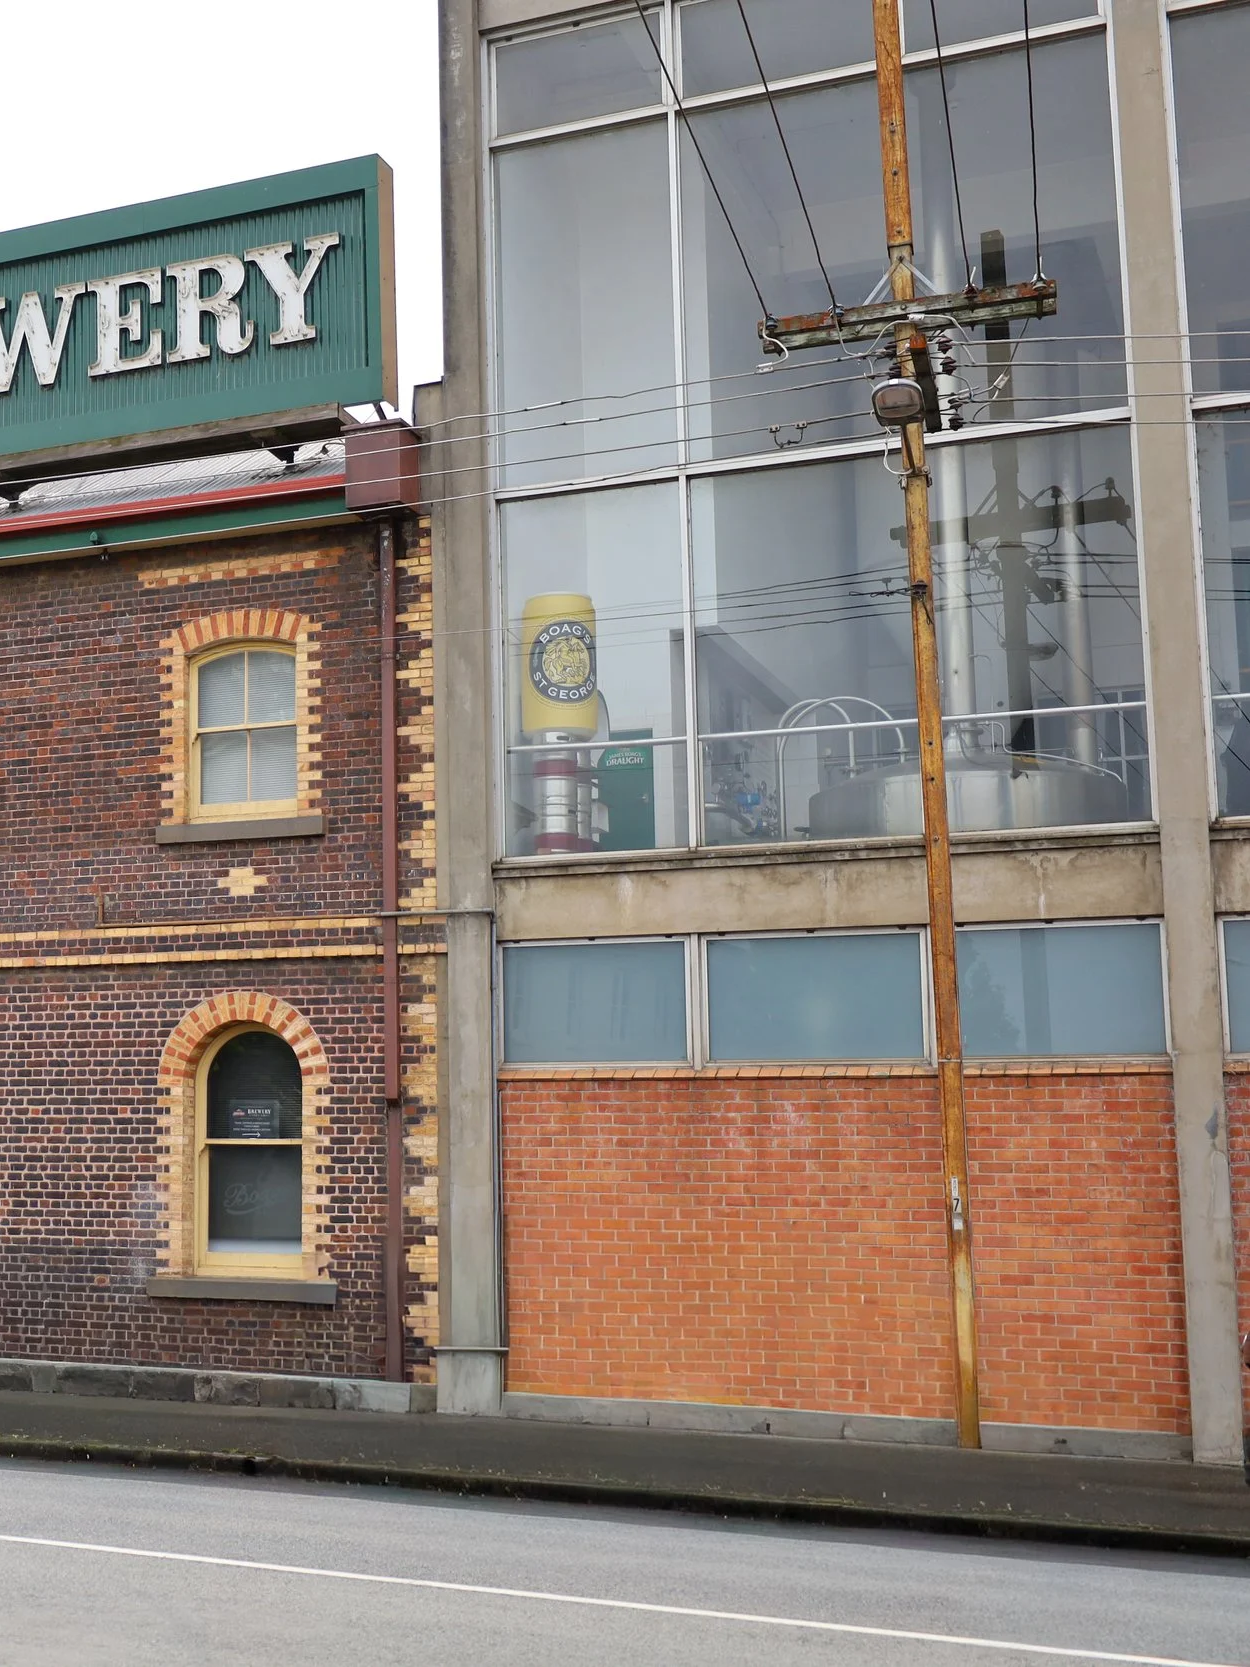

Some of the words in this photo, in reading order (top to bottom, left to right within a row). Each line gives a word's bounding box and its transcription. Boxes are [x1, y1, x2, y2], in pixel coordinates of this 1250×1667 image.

[539, 623, 592, 645] BOAG'S
[533, 671, 548, 689] ST
[547, 671, 596, 700] GEORGE
[606, 756, 645, 767] DRAUGHT
[953, 1198, 960, 1212] 7
